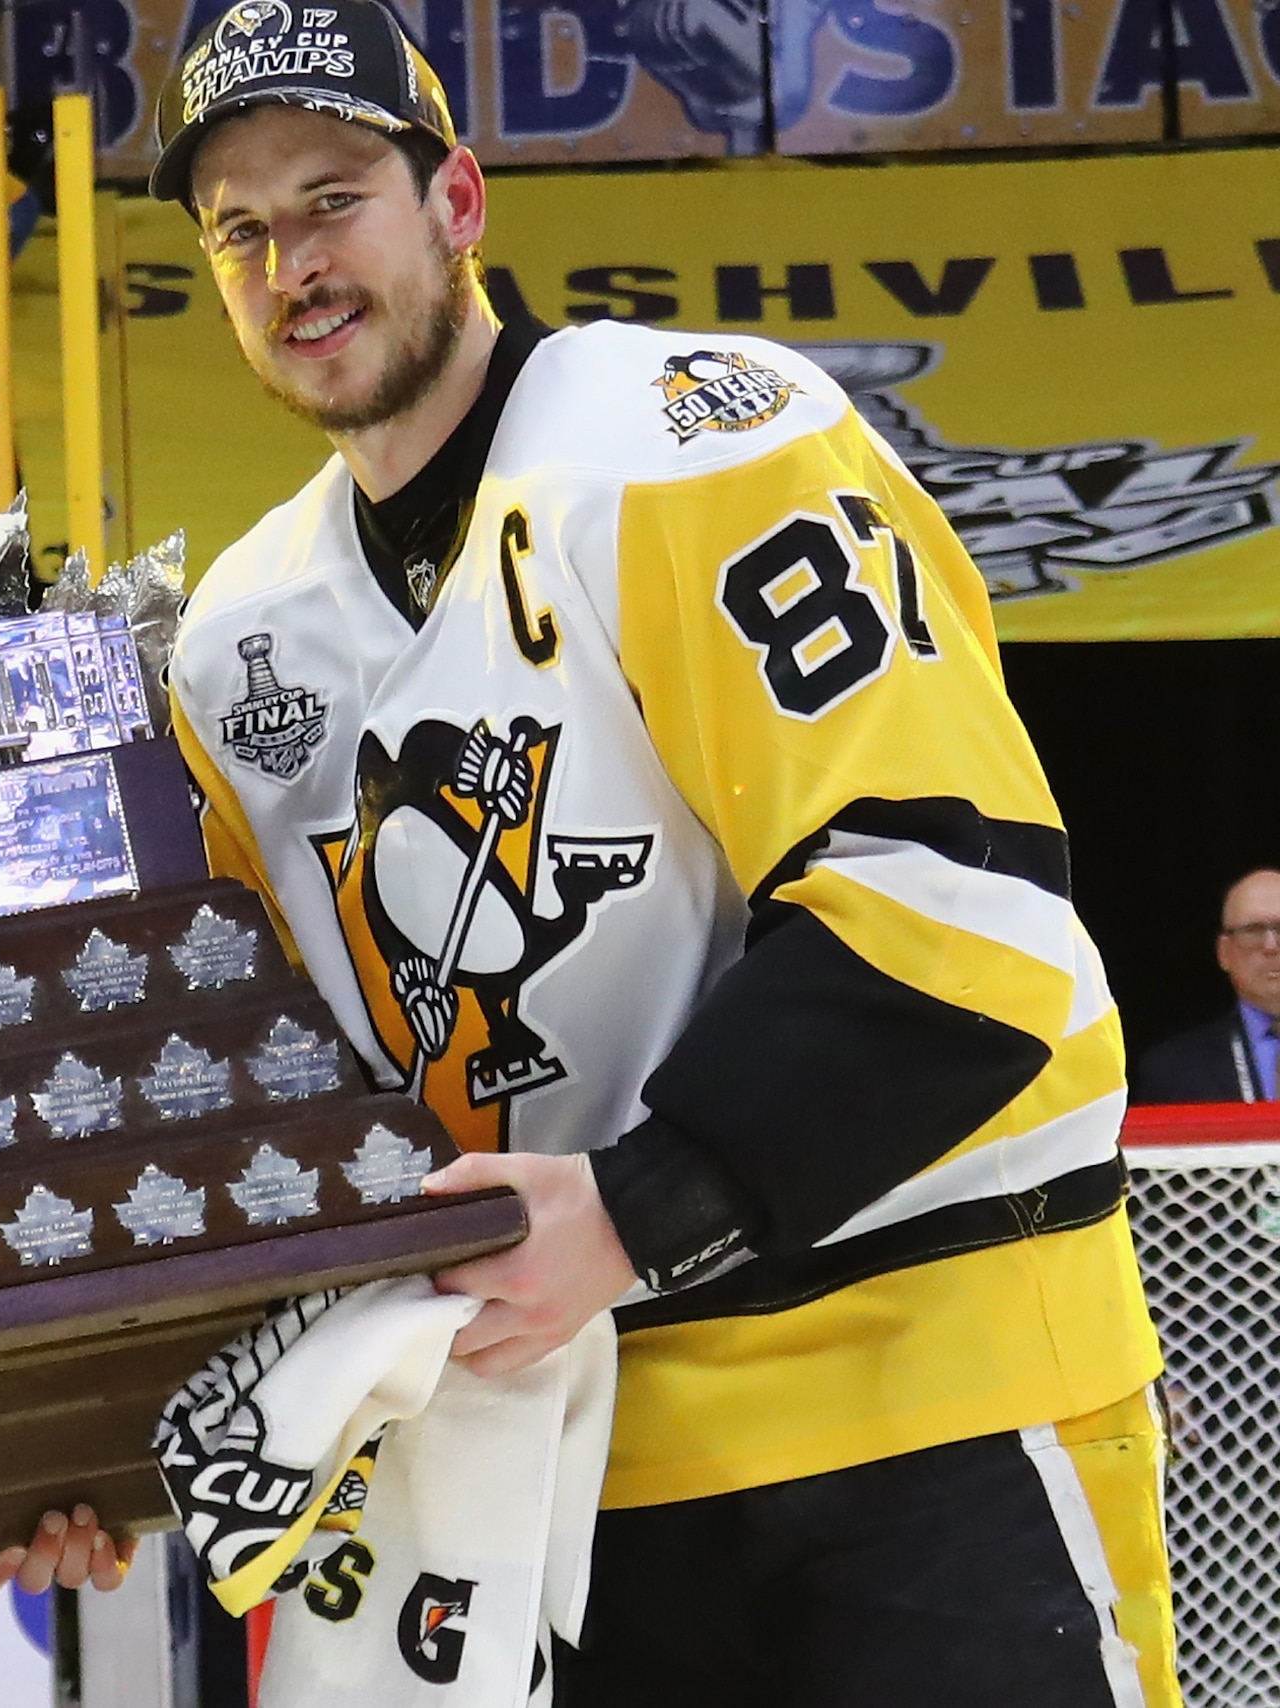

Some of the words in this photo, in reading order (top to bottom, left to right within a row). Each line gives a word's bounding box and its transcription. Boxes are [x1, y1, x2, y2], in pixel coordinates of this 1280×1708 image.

[302, 8, 338, 28] 17
[182, 35, 283, 98] STANLEY
[296, 32, 349, 48] CUP
[183, 48, 355, 125] CHAMPS
[825, 0, 1280, 116] STA
[667, 394, 711, 427] 50
[704, 369, 783, 403] YEARS
[500, 502, 564, 672] C
[714, 488, 944, 723] 87
[224, 696, 323, 742] FINAL
[232, 695, 280, 716] STANLEY
[279, 689, 305, 702] CUP
[397, 1572, 479, 1685] G
